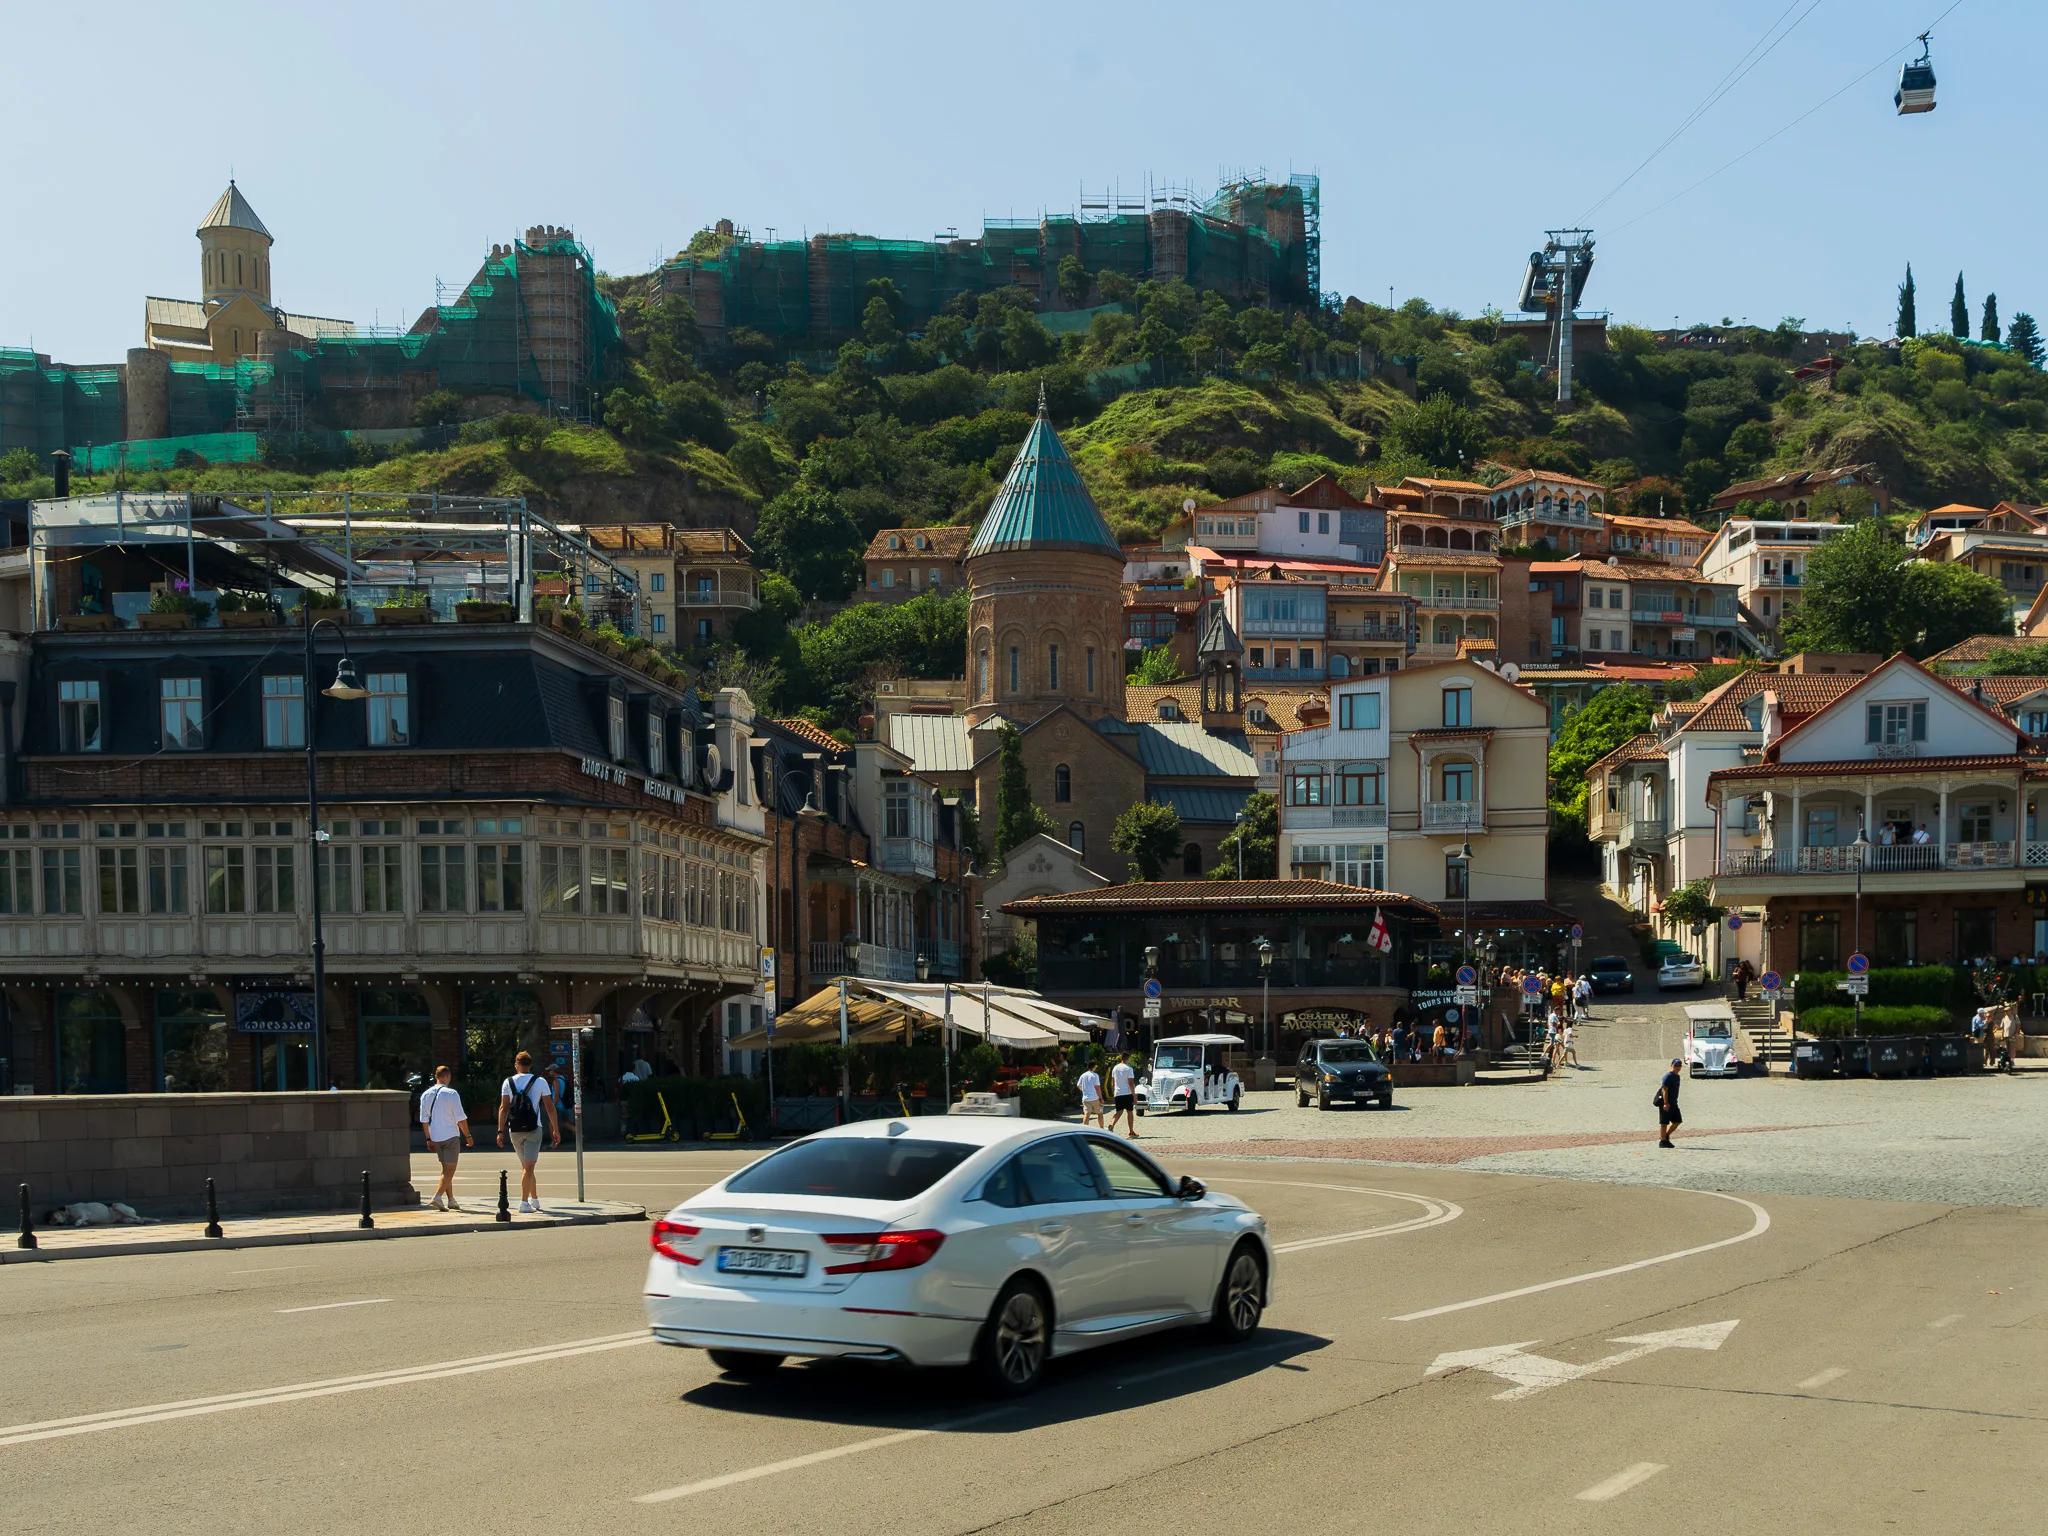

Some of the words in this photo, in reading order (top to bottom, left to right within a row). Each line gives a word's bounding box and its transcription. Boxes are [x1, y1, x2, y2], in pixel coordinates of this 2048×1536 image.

[644, 779, 671, 801] MEIDAN
[673, 790, 686, 805] INN
[1169, 997, 1205, 1008] WINE
[1210, 997, 1242, 1009] BAR
[1417, 997, 1442, 1011] TOURS
[1443, 996, 1451, 1004] IN
[1298, 1011, 1349, 1020] CHÂTEAU
